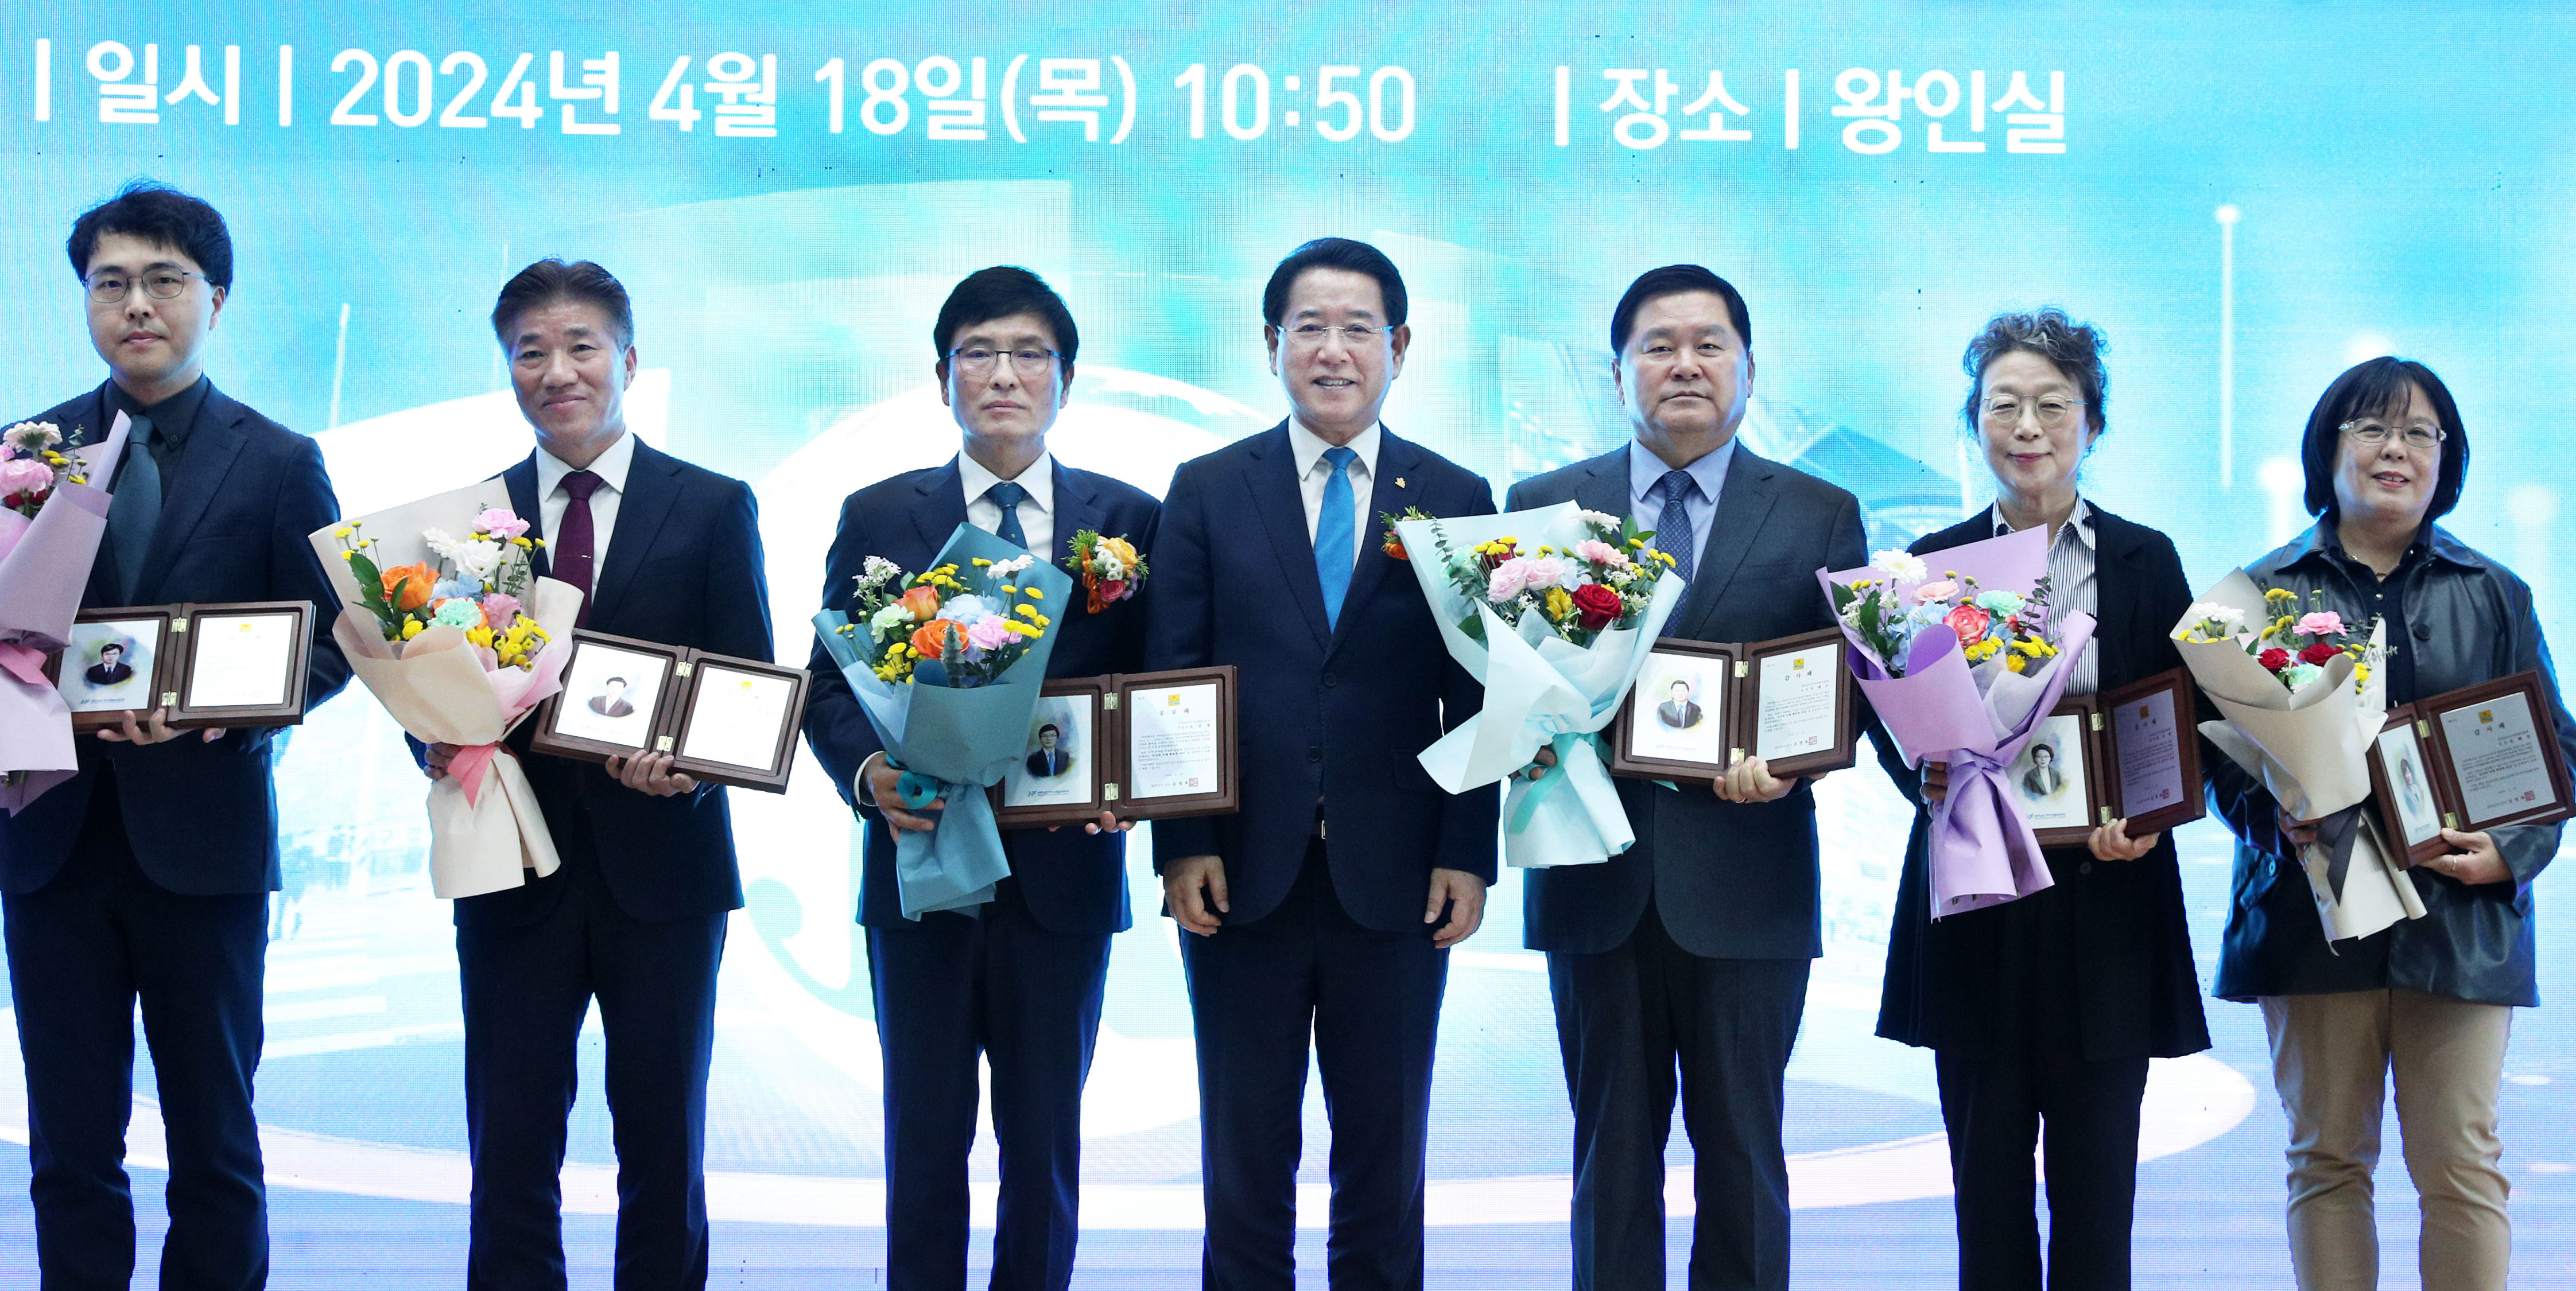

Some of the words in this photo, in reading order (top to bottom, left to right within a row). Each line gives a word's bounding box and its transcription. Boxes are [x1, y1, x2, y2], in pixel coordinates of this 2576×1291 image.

[87, 41, 239, 125] 일시
[331, 49, 620, 135] 2024년
[649, 52, 777, 137] 4월
[815, 55, 1136, 144] 18일(목)
[1175, 64, 1415, 142] 10:50
[1600, 68, 1752, 149] 장소
[1832, 67, 2066, 154] 왕인실
